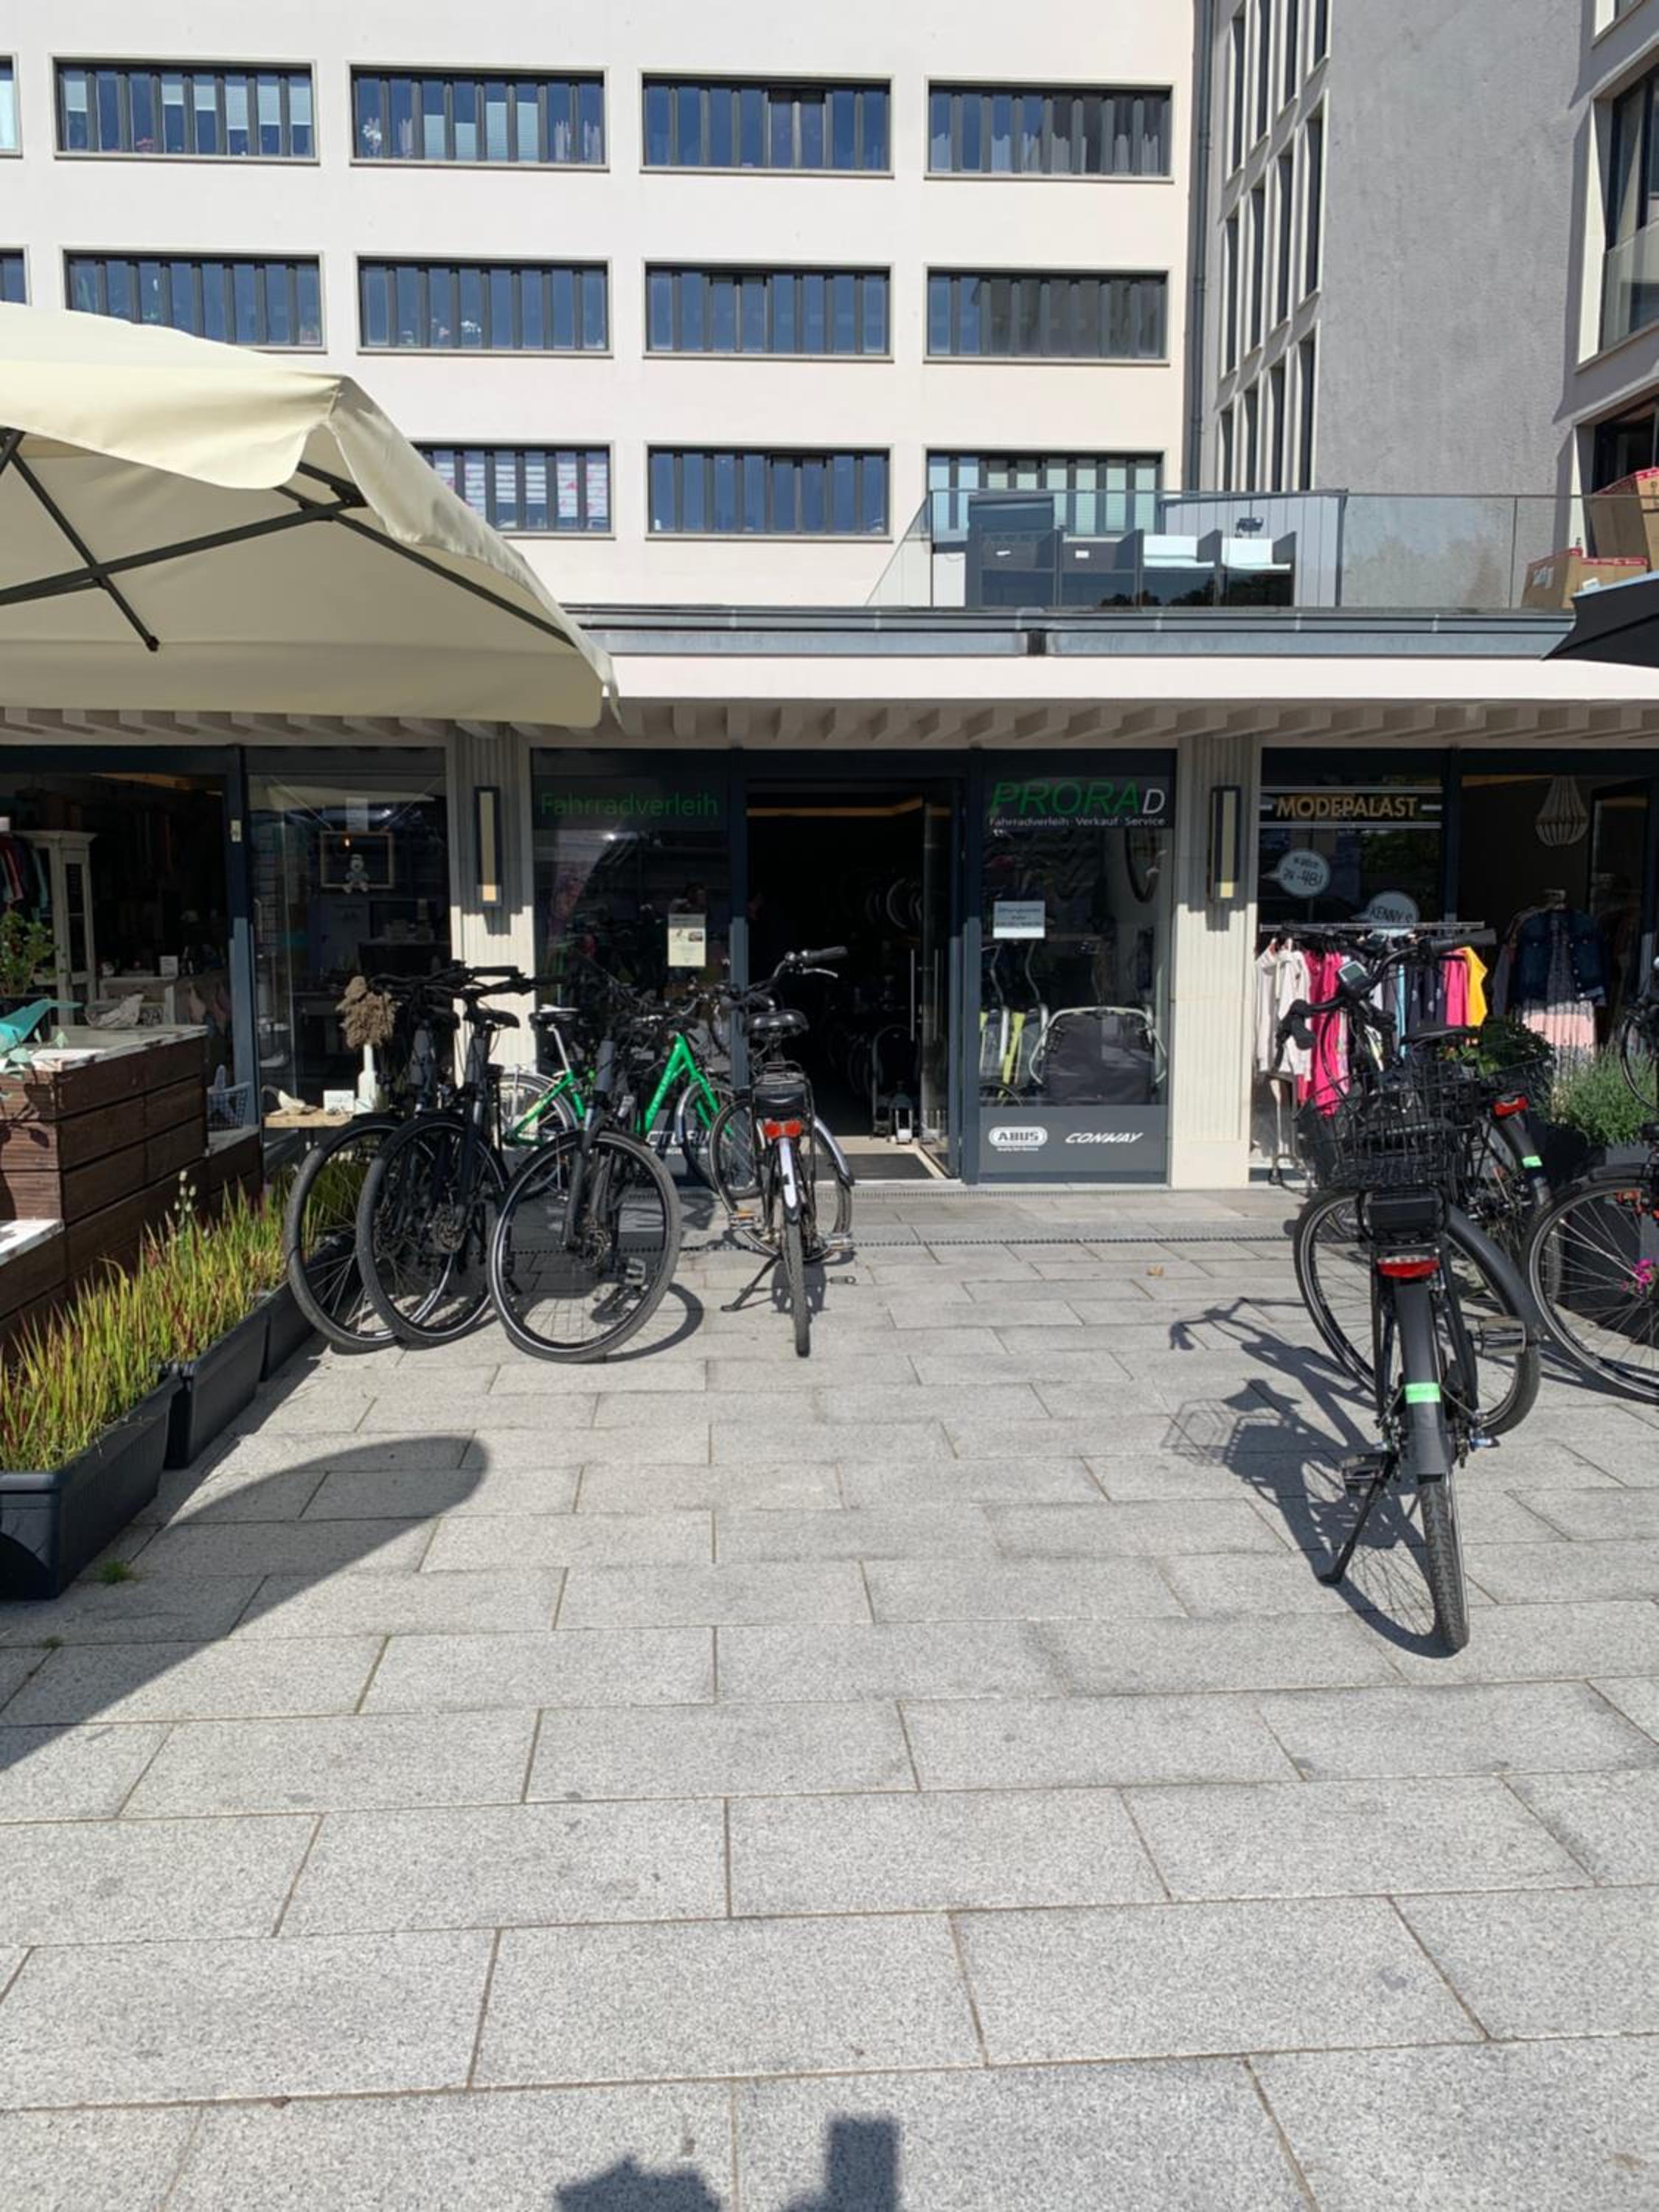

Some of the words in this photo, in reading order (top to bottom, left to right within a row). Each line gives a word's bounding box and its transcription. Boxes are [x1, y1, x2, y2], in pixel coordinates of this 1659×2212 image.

[541, 792, 718, 815] Fahrradverleih
[1276, 796, 1418, 818] MODEPALAST
[989, 816, 1069, 827] Fahrradverleih
[1075, 816, 1119, 827] Verkauf
[1124, 816, 1166, 827] Service
[1065, 1132, 1144, 1144] CONWAY
